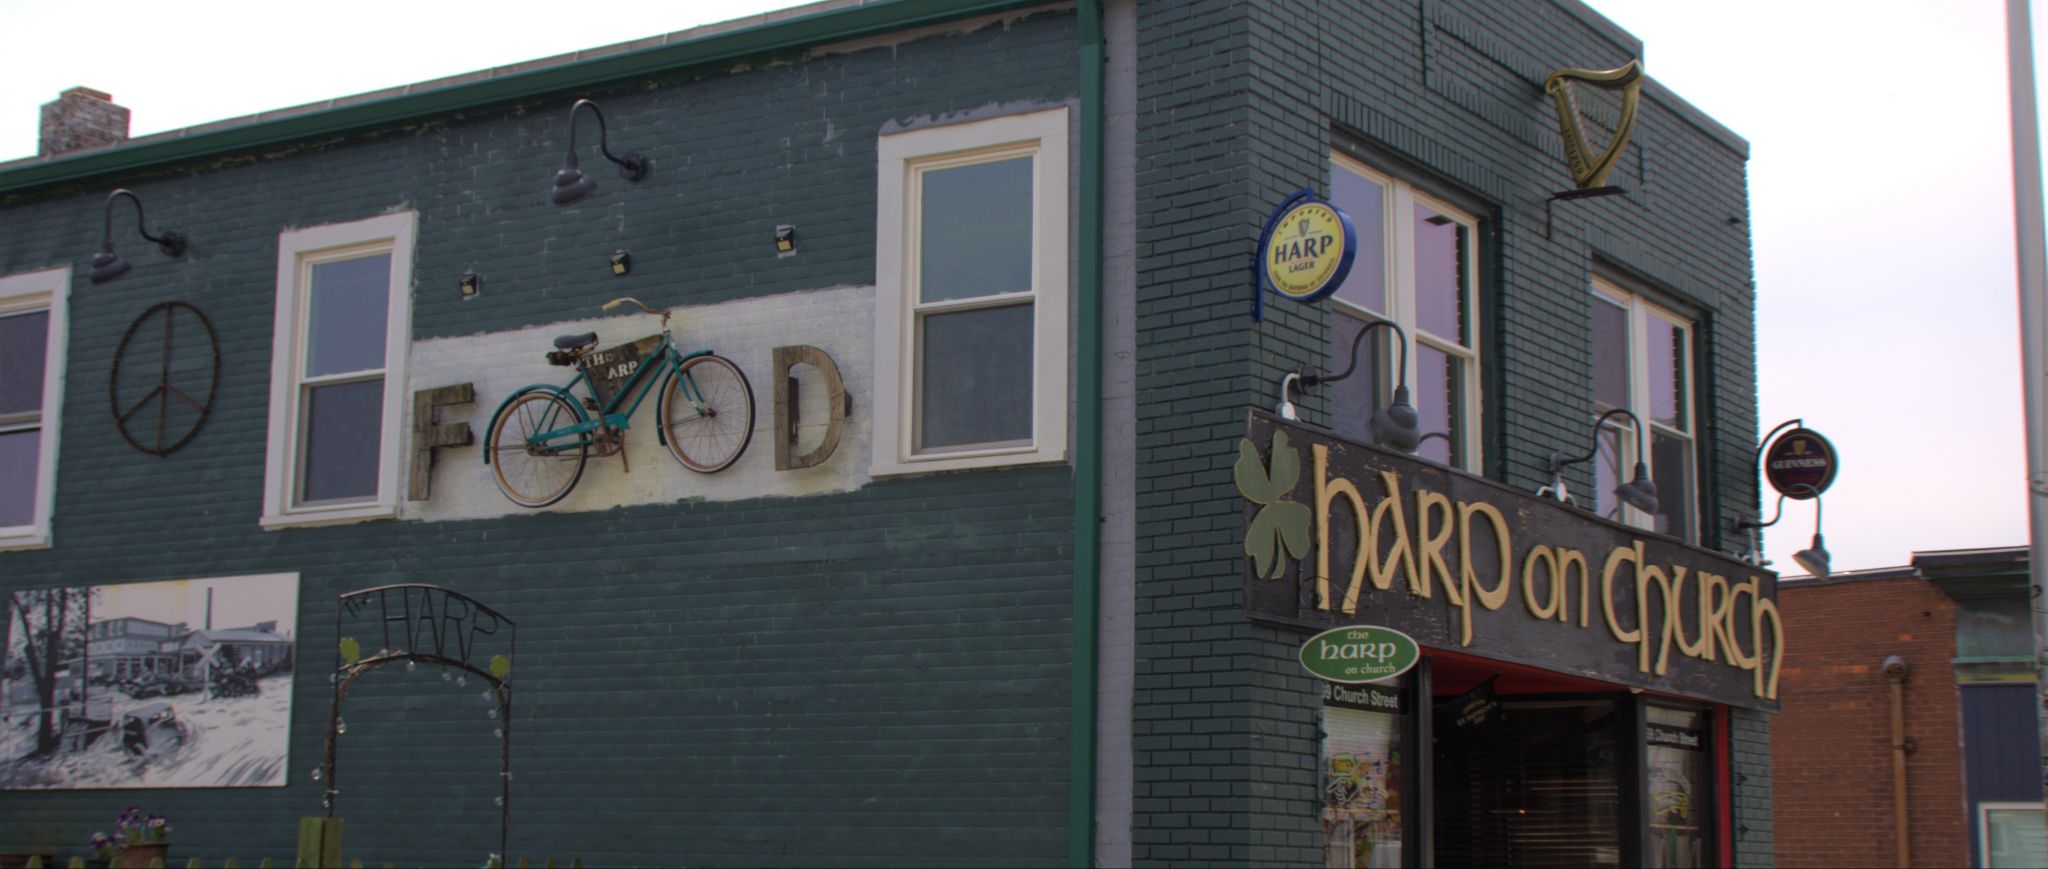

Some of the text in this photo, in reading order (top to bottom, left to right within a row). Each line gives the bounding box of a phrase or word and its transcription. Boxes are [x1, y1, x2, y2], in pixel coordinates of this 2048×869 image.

[1274, 235, 1334, 265] HARP
[1288, 261, 1316, 273] LAGER
[381, 586, 499, 666] HARP
[1347, 631, 1370, 640] the
[1345, 662, 1396, 675] on church
[1333, 685, 1369, 706] Church
[1371, 690, 1399, 708] Street
